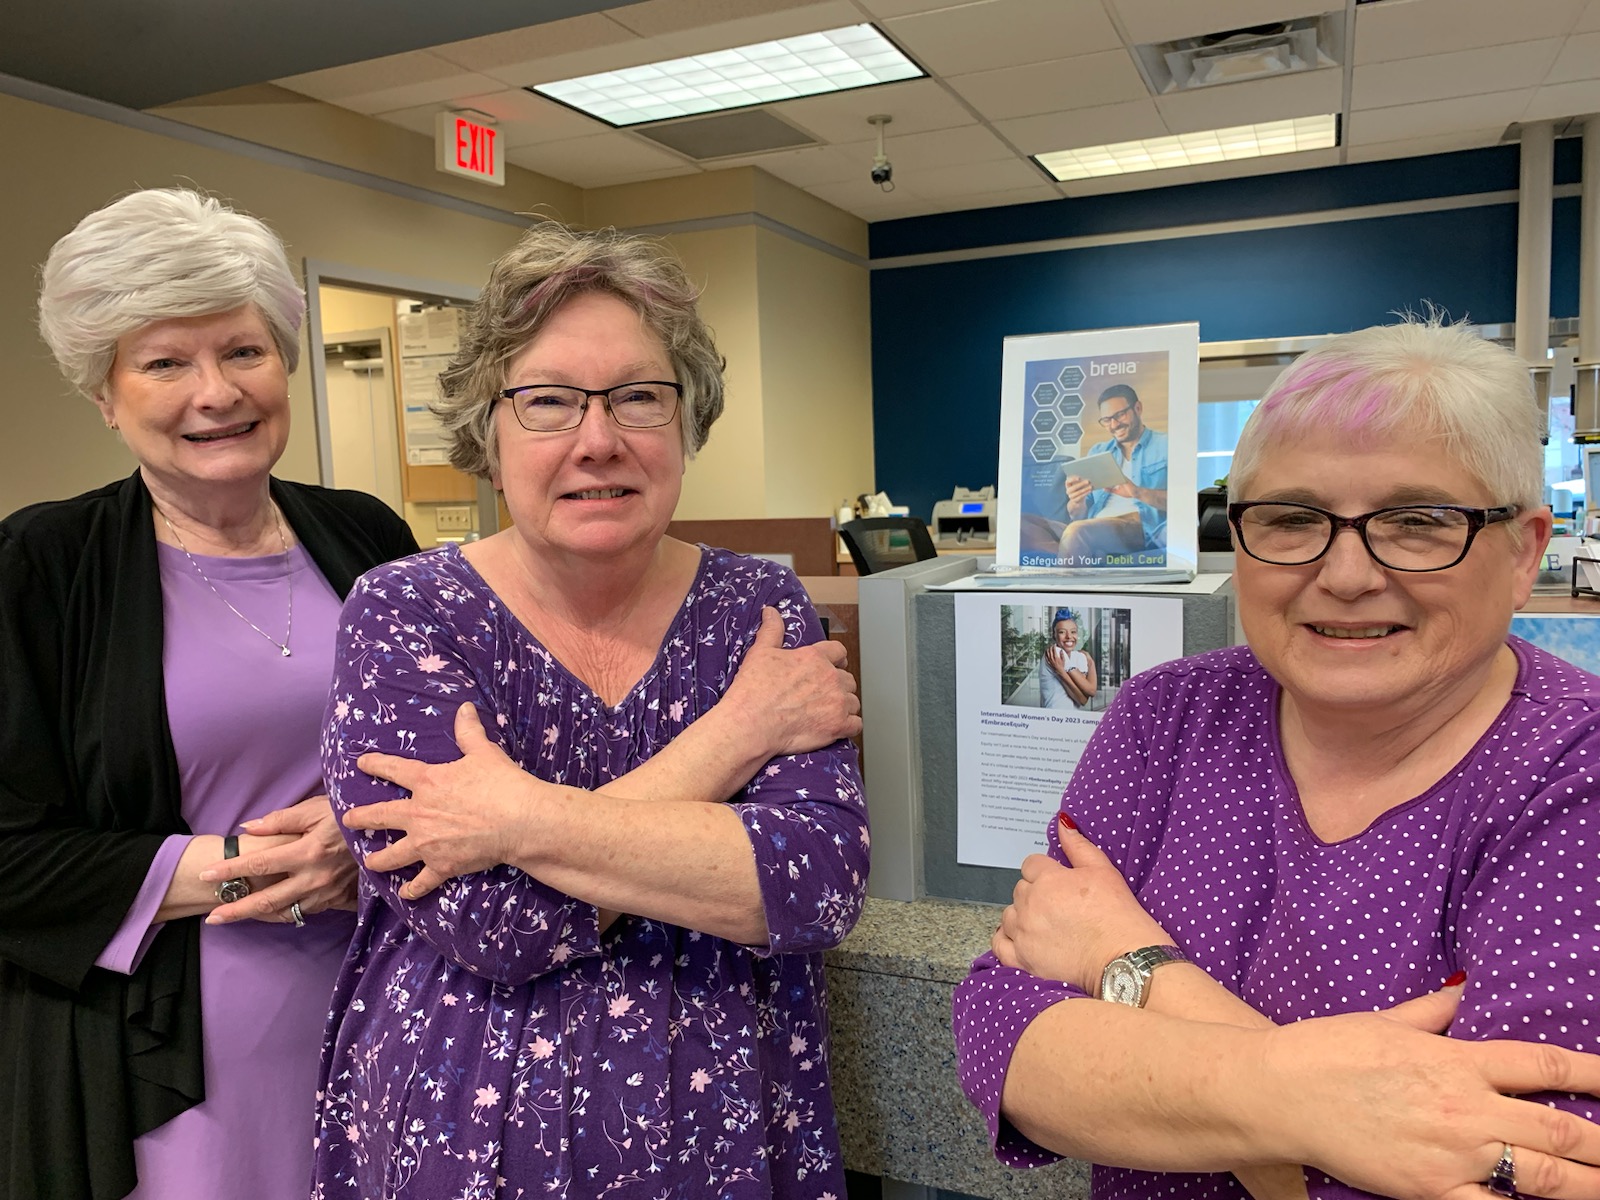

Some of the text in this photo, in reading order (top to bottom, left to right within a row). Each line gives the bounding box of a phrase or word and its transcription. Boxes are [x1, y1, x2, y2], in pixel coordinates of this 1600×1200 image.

[455, 117, 496, 176] EXIT
[1090, 361, 1137, 376] brella
[1022, 554, 1164, 567] Safeguard Your Debit Card
[980, 710, 1020, 720] International
[1021, 713, 1050, 721] Women's
[1051, 716, 1064, 724] Day
[981, 719, 1030, 729] #EmbraceEquity
